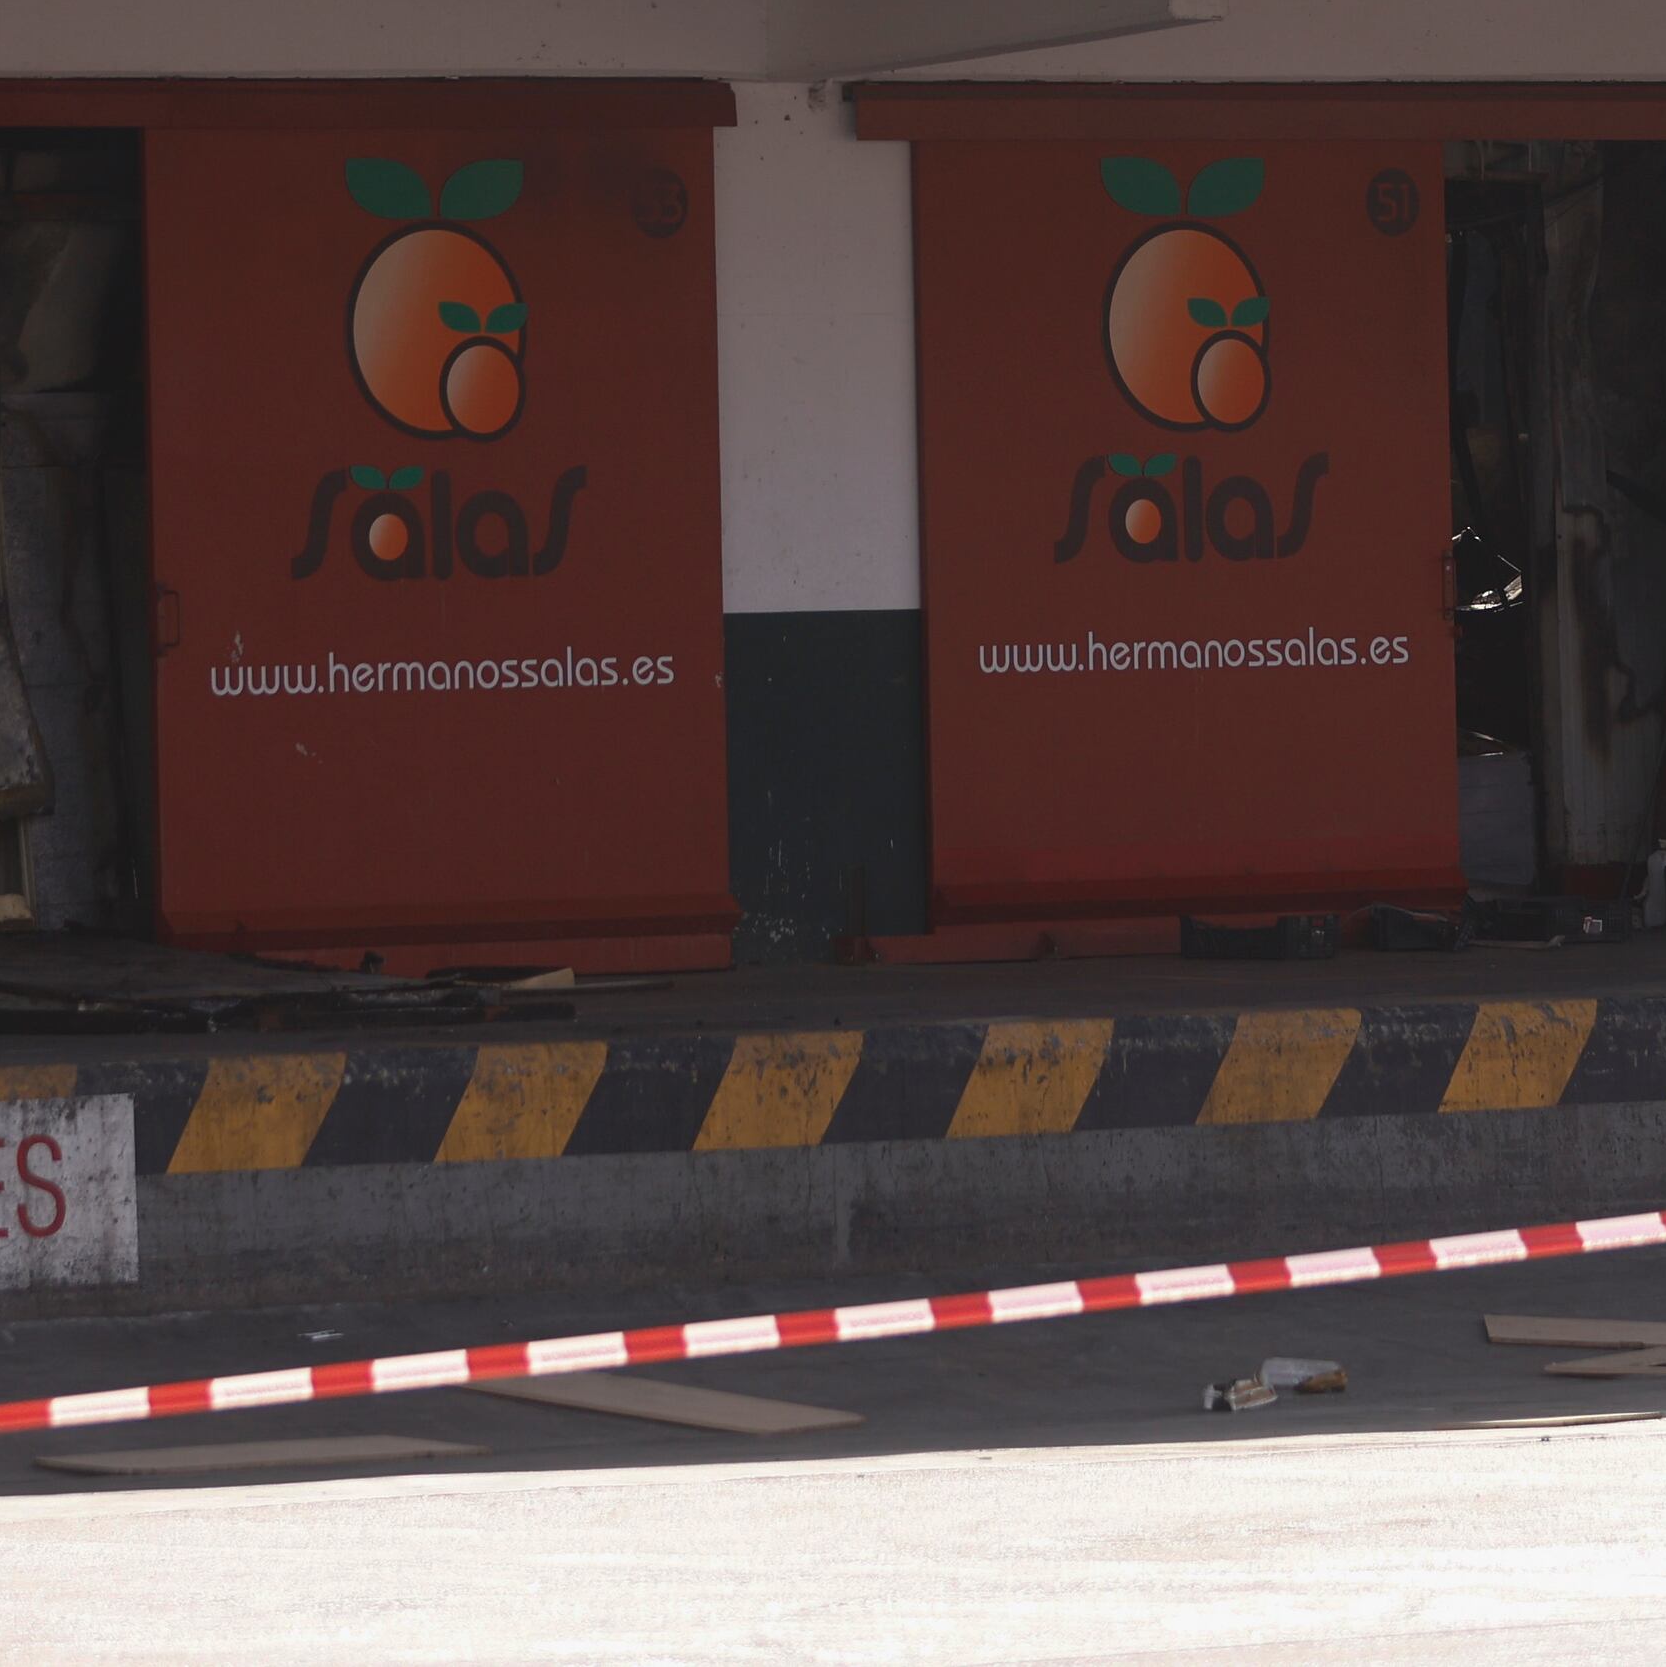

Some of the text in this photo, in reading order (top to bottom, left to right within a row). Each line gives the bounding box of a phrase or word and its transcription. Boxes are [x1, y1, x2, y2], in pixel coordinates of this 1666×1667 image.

[1377, 182, 1410, 223] 51
[209, 646, 676, 696] www.hermanossalas.es
[978, 626, 1410, 674] www.hermanossalas.es
